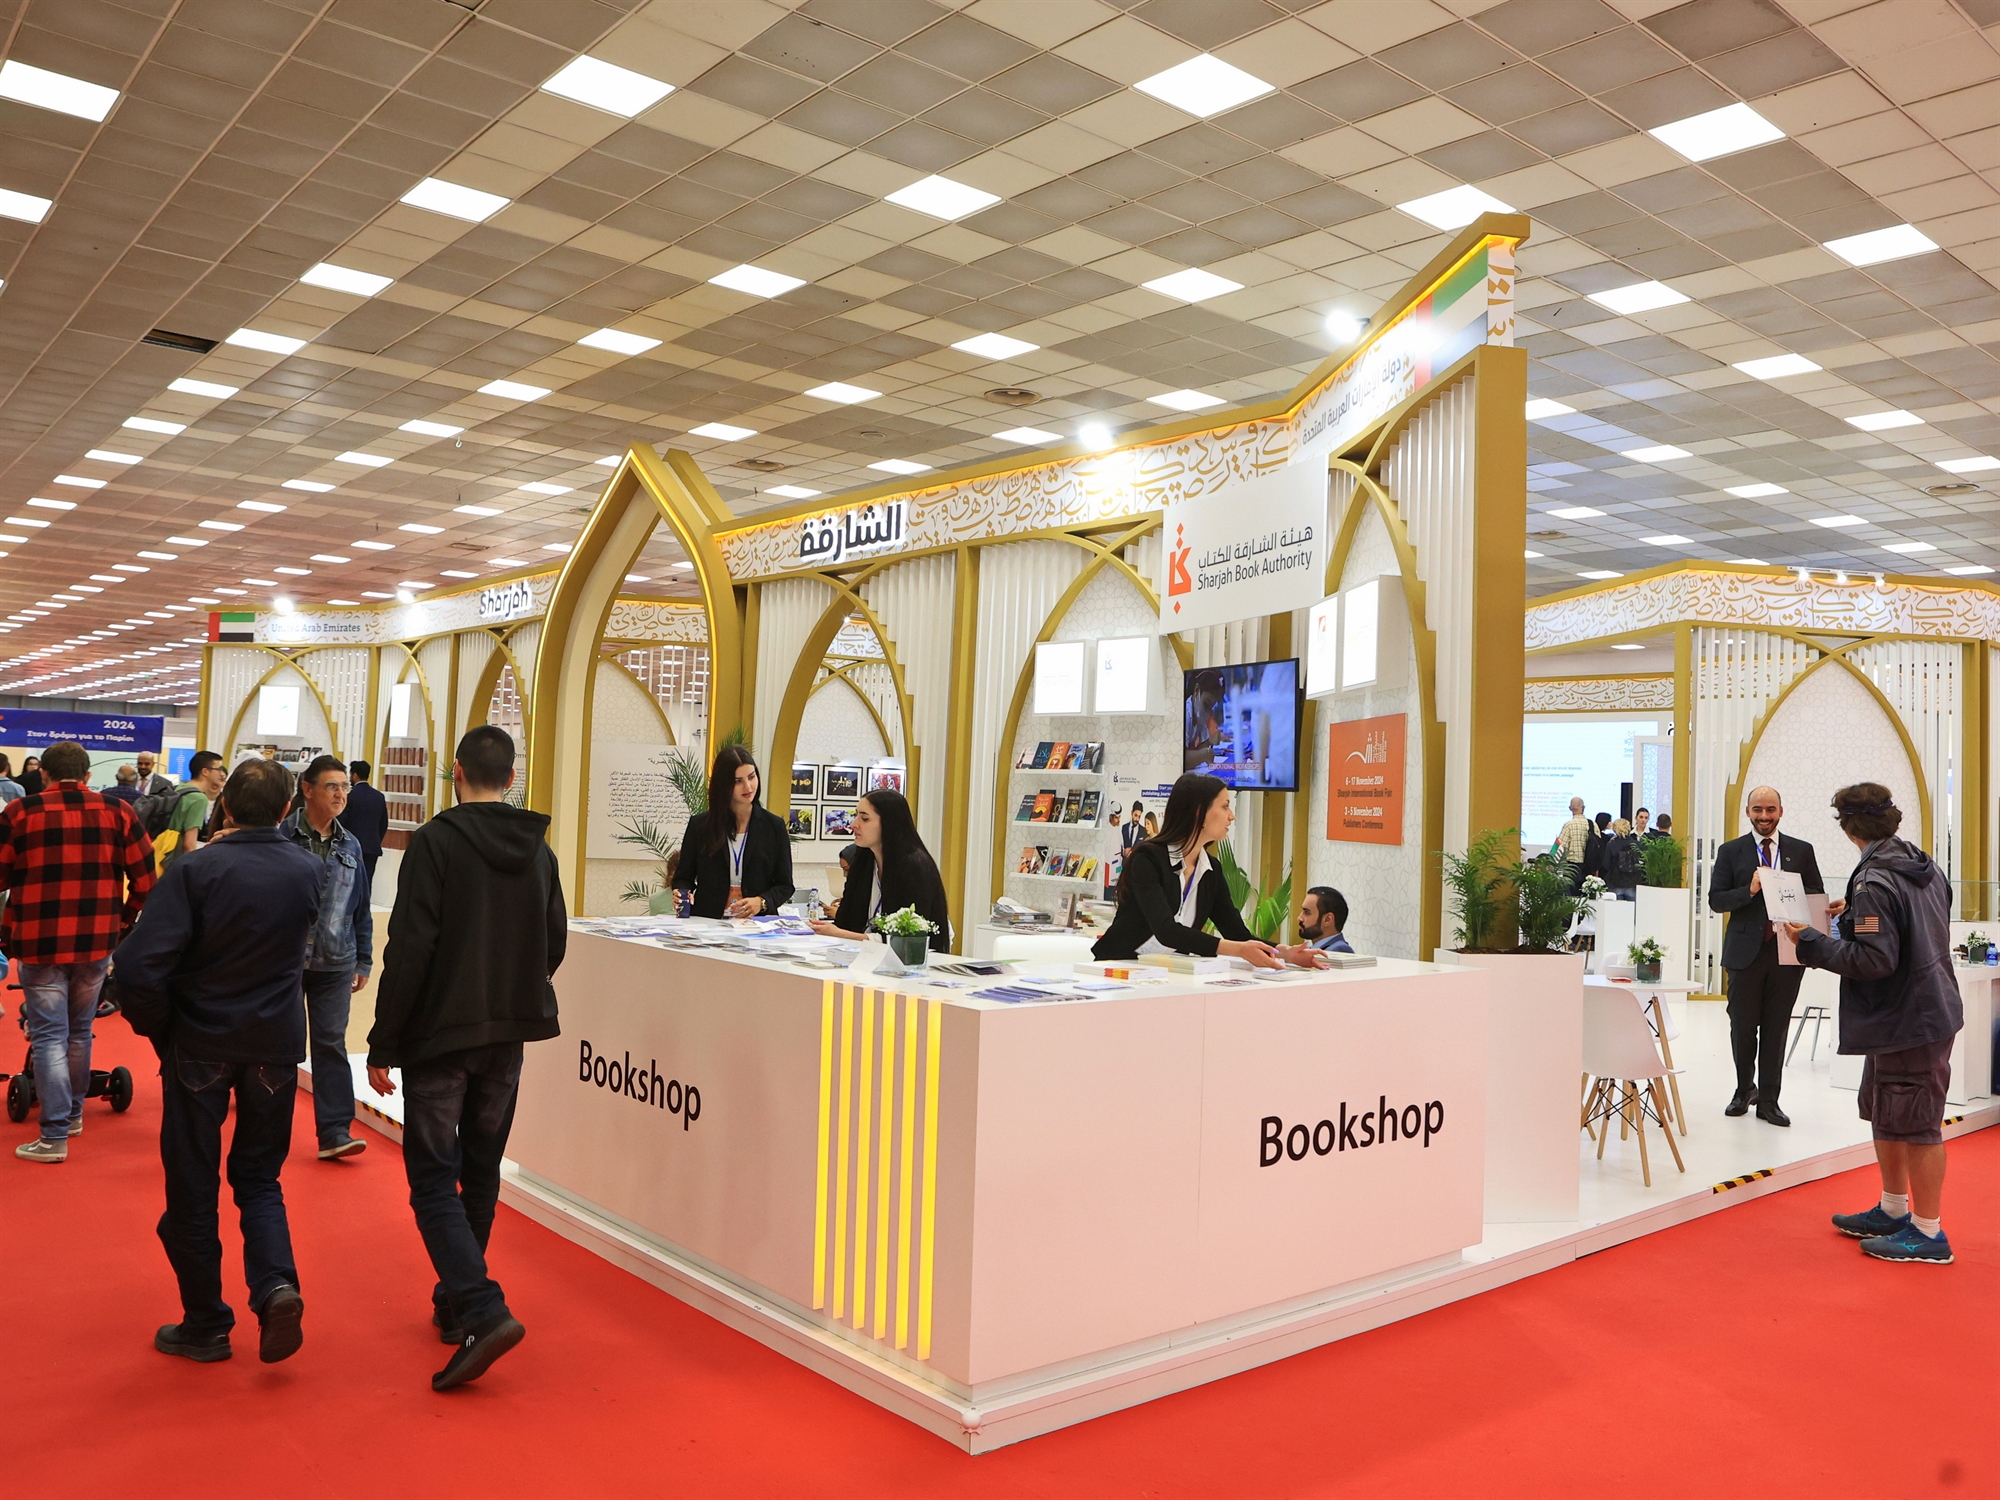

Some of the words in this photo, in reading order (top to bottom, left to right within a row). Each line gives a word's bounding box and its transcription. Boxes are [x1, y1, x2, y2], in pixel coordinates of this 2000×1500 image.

[1382, 358, 1401, 384] دولة
[1327, 392, 1351, 428] العربية
[1303, 411, 1326, 445] المتحدة
[800, 504, 902, 561] الشارقة
[1234, 532, 1277, 560] الشارقة
[1280, 526, 1313, 547] هيئة
[1197, 567, 1233, 590] Sharjah
[1235, 561, 1260, 582] Book
[1261, 550, 1313, 576] Authority
[1198, 544, 1232, 572] للكتاب
[479, 582, 529, 617] Sharjah
[301, 623, 321, 632] Arab
[323, 623, 361, 632] Emirates
[26, 730, 48, 738] Στον
[49, 730, 77, 740] δρόμο
[106, 734, 135, 742] Παρίσι
[103, 719, 136, 730] 2024
[1337, 788, 1350, 799] Sharjah
[1351, 788, 1373, 798] International
[1374, 788, 1384, 798] Book
[1345, 777, 1349, 786] 6
[1351, 776, 1356, 785] 17
[1356, 776, 1374, 786] November
[1374, 775, 1384, 785] 2024
[1343, 819, 1361, 829] Publishers
[1362, 820, 1384, 830] Conference
[1344, 806, 1348, 816] 3
[1350, 806, 1353, 816] 5
[1353, 806, 1373, 816] November
[1373, 806, 1383, 817] 2024
[580, 1040, 701, 1131] Bookshop
[1260, 1095, 1445, 1167] Bookshop
